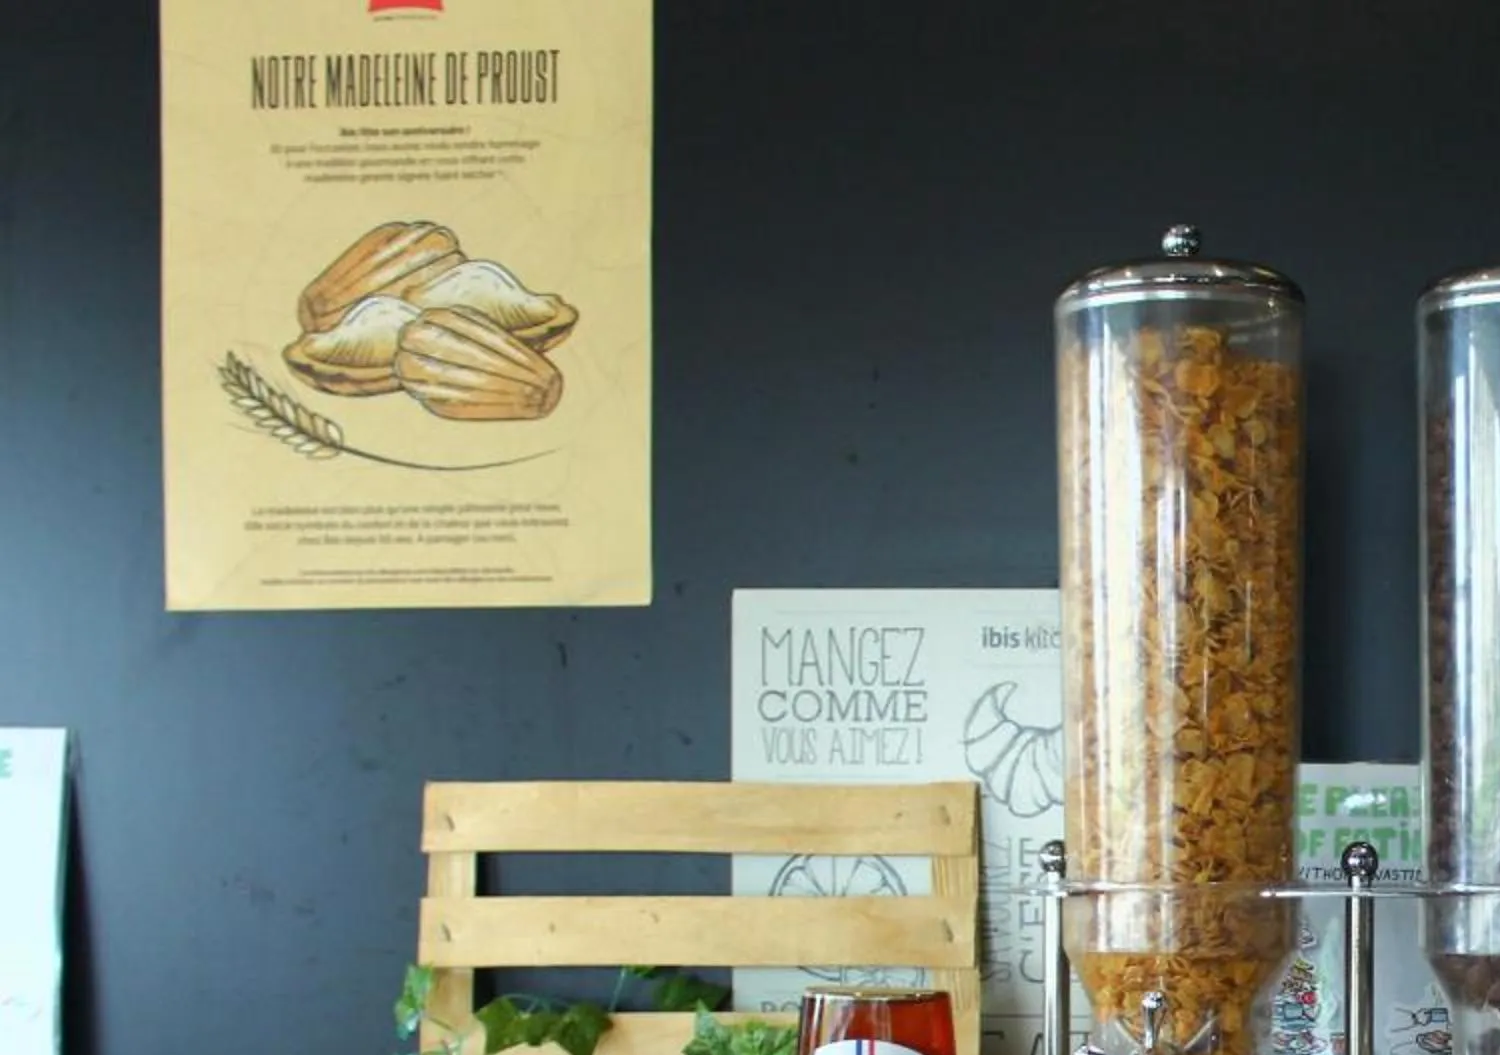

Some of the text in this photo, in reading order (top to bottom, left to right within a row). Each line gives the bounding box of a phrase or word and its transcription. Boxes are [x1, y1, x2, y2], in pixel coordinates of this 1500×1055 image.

[252, 49, 560, 109] NOTRE MADELEINE DE PROUST
[982, 626, 1020, 648] ibis
[760, 626, 925, 686] MANGEZ
[757, 690, 928, 722] COMME
[762, 727, 817, 764] VOUS
